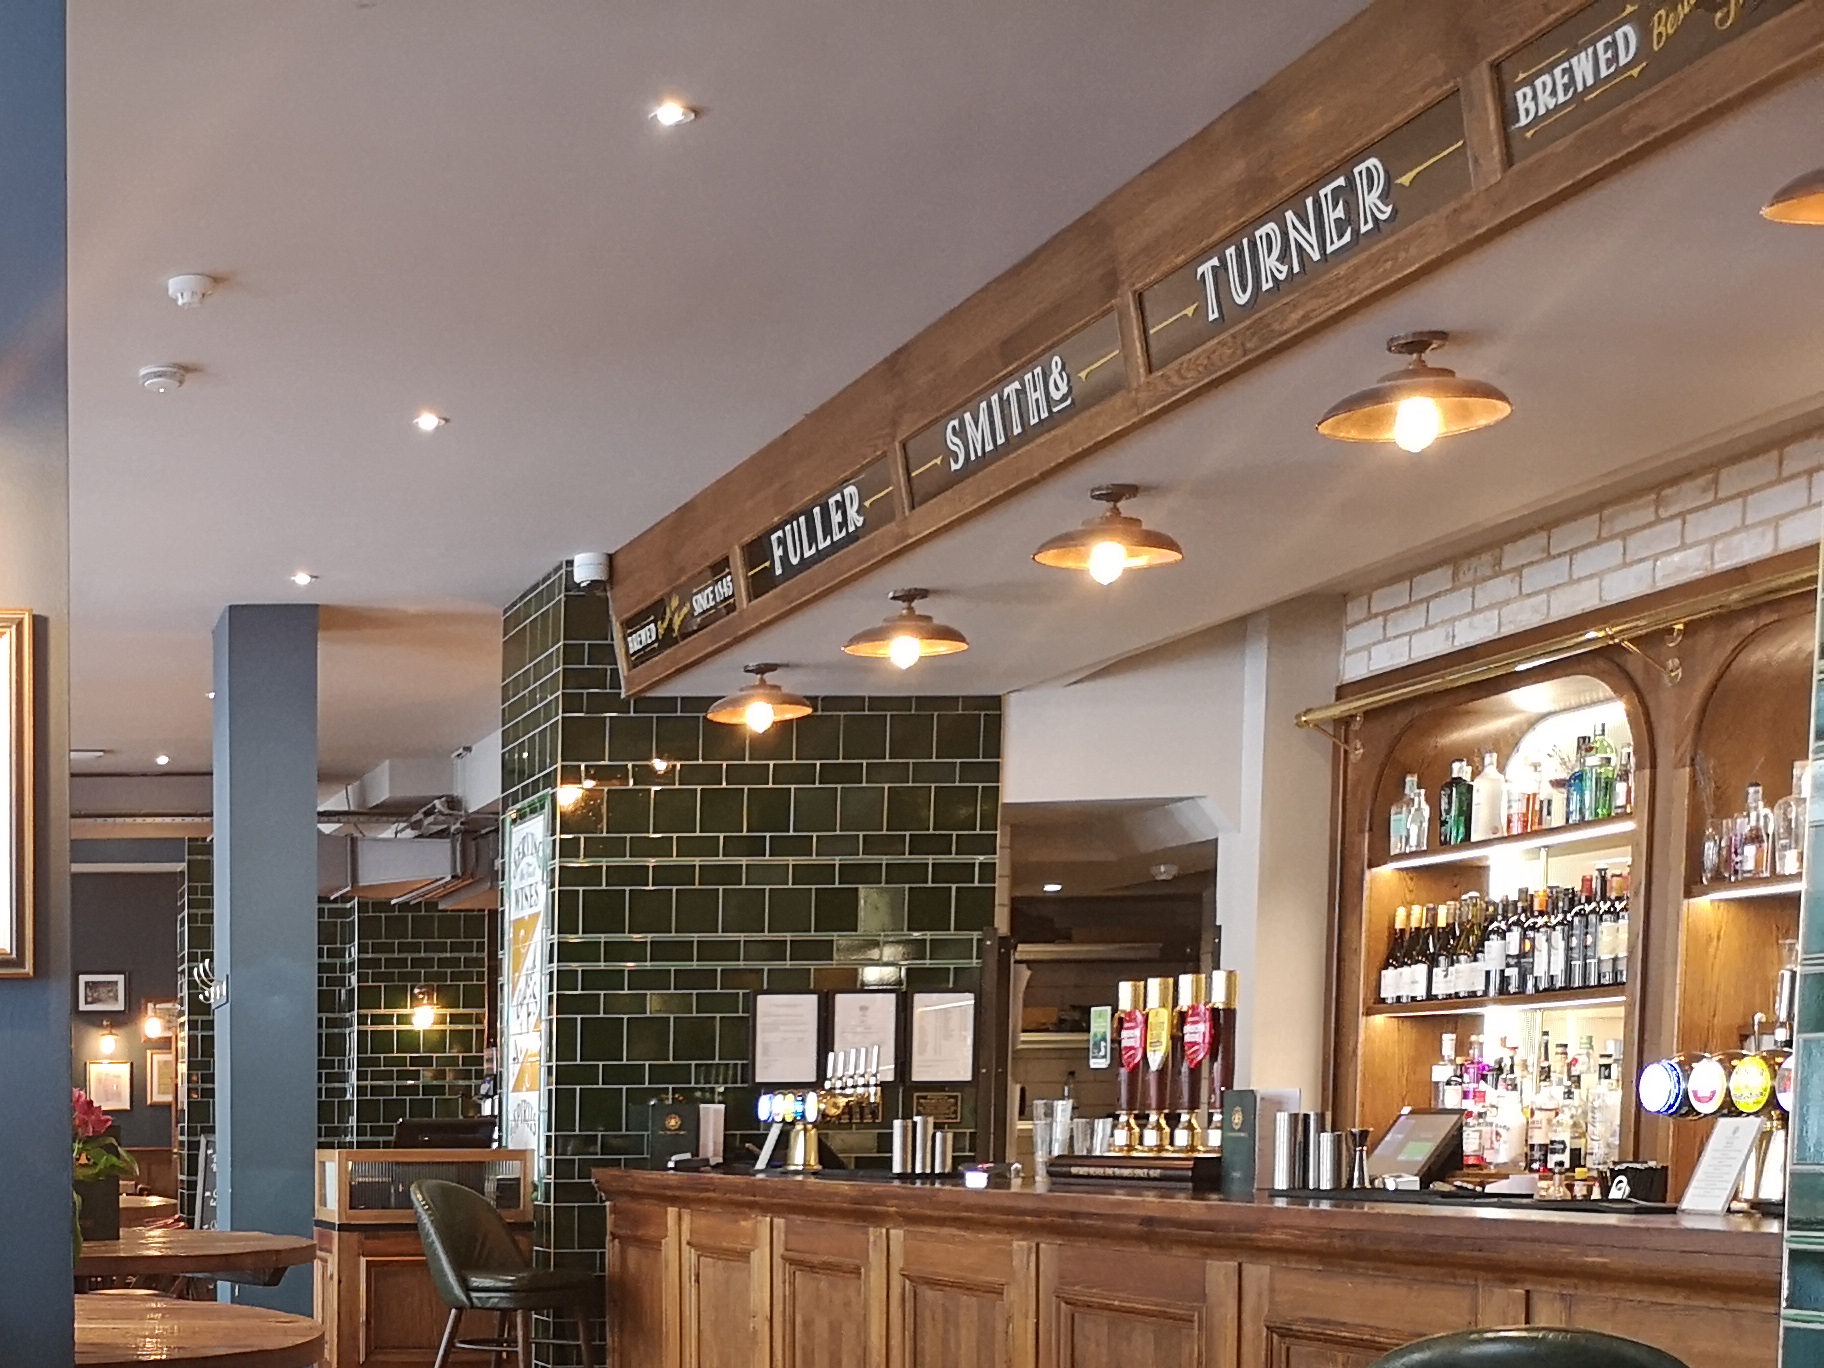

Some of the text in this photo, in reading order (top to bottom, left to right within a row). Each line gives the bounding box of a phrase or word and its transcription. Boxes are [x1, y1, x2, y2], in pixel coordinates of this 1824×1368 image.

[1512, 23, 1638, 129] BREWED
[1197, 157, 1393, 322] TURNER
[771, 485, 864, 576] FULLER
[692, 585, 716, 616] SINCE
